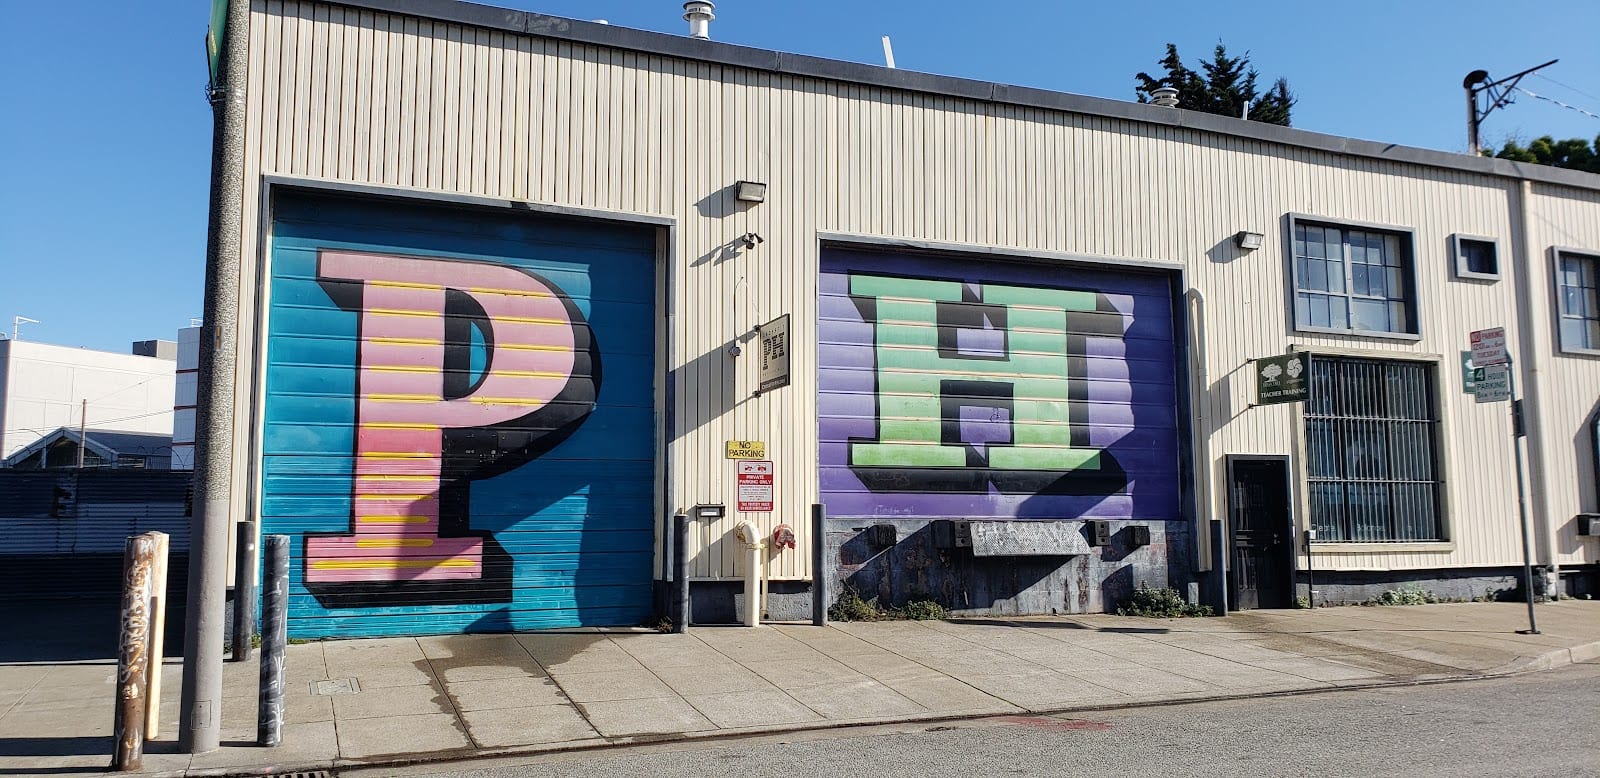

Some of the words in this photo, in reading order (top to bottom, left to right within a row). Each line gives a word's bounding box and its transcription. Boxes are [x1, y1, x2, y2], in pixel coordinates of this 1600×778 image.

[848, 269, 1117, 487] H
[1475, 369, 1484, 380] 4
[1488, 372, 1505, 380] HOUR
[1476, 381, 1506, 390] PARKING
[1283, 387, 1307, 396] TRAINING
[304, 247, 597, 607] P
[739, 441, 751, 449] NO
[728, 449, 765, 458] PARKING
